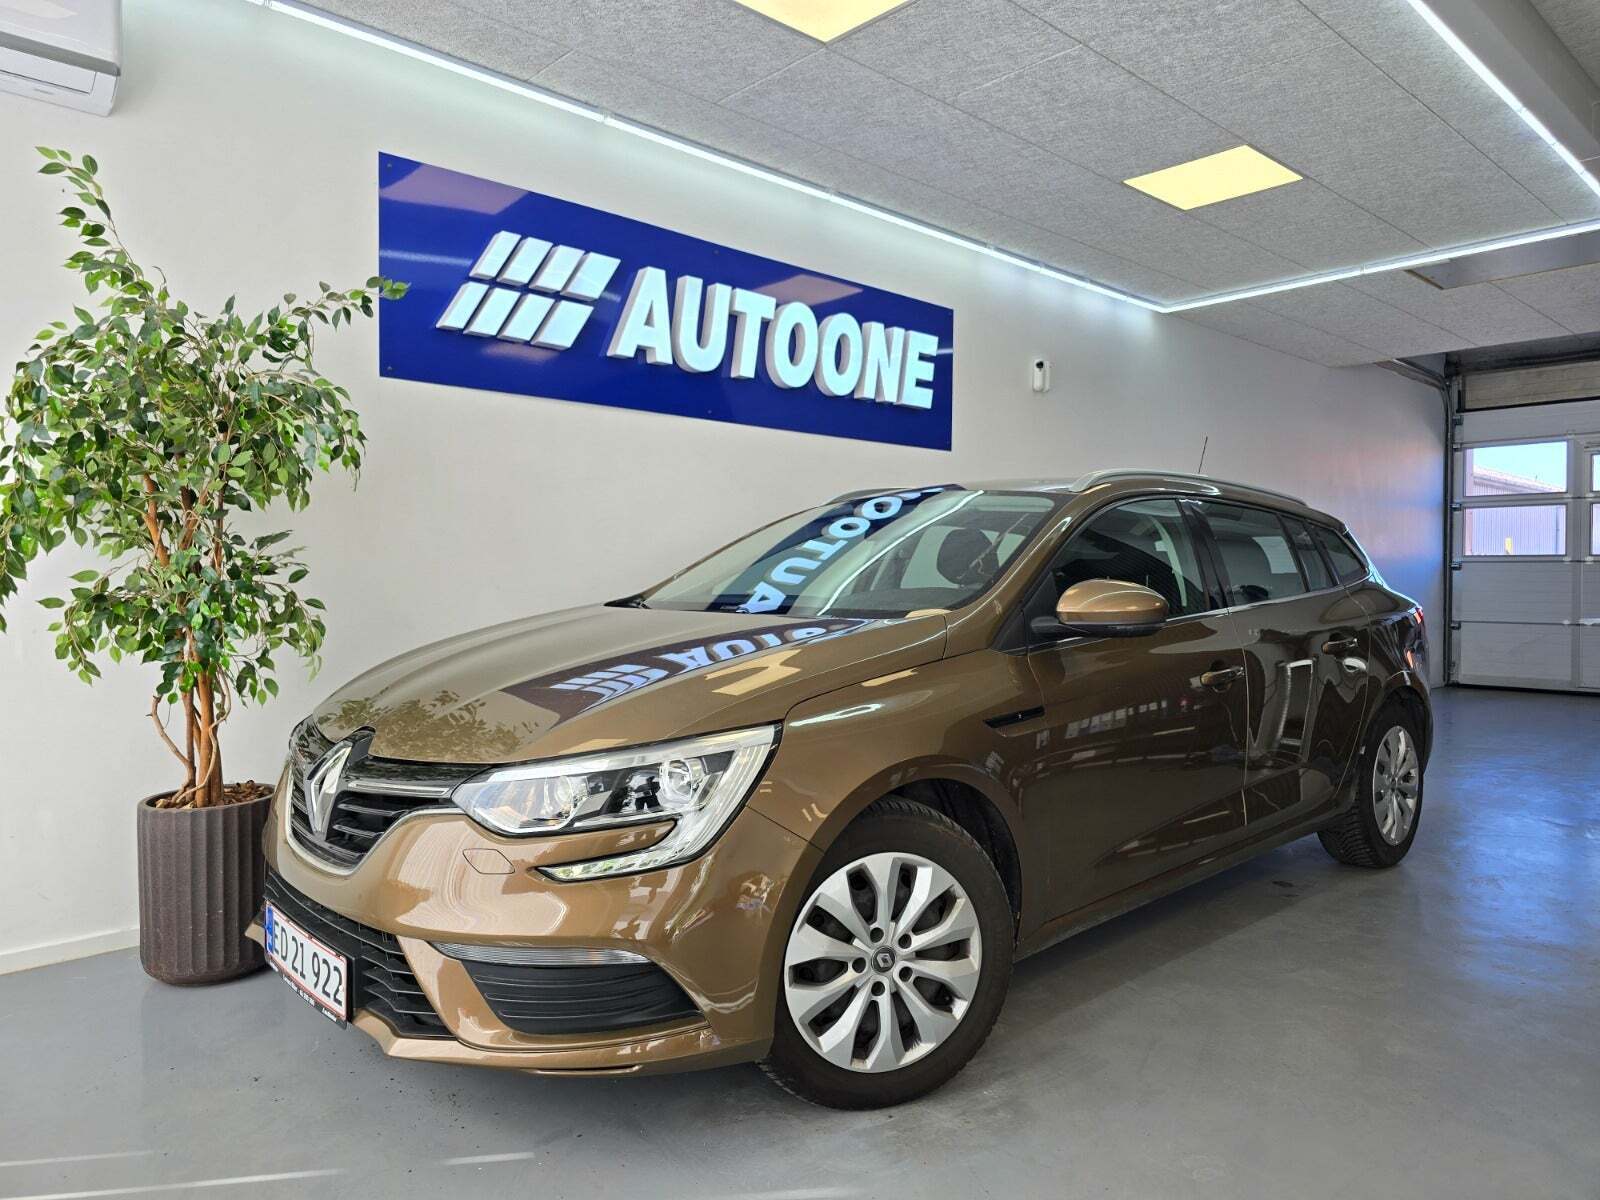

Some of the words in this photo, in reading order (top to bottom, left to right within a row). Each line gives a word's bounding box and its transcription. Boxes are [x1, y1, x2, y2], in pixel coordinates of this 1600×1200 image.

[606, 266, 940, 410] AUTOONE
[273, 919, 289, 962] ED
[291, 935, 306, 980] 21
[312, 951, 343, 1007] 922
